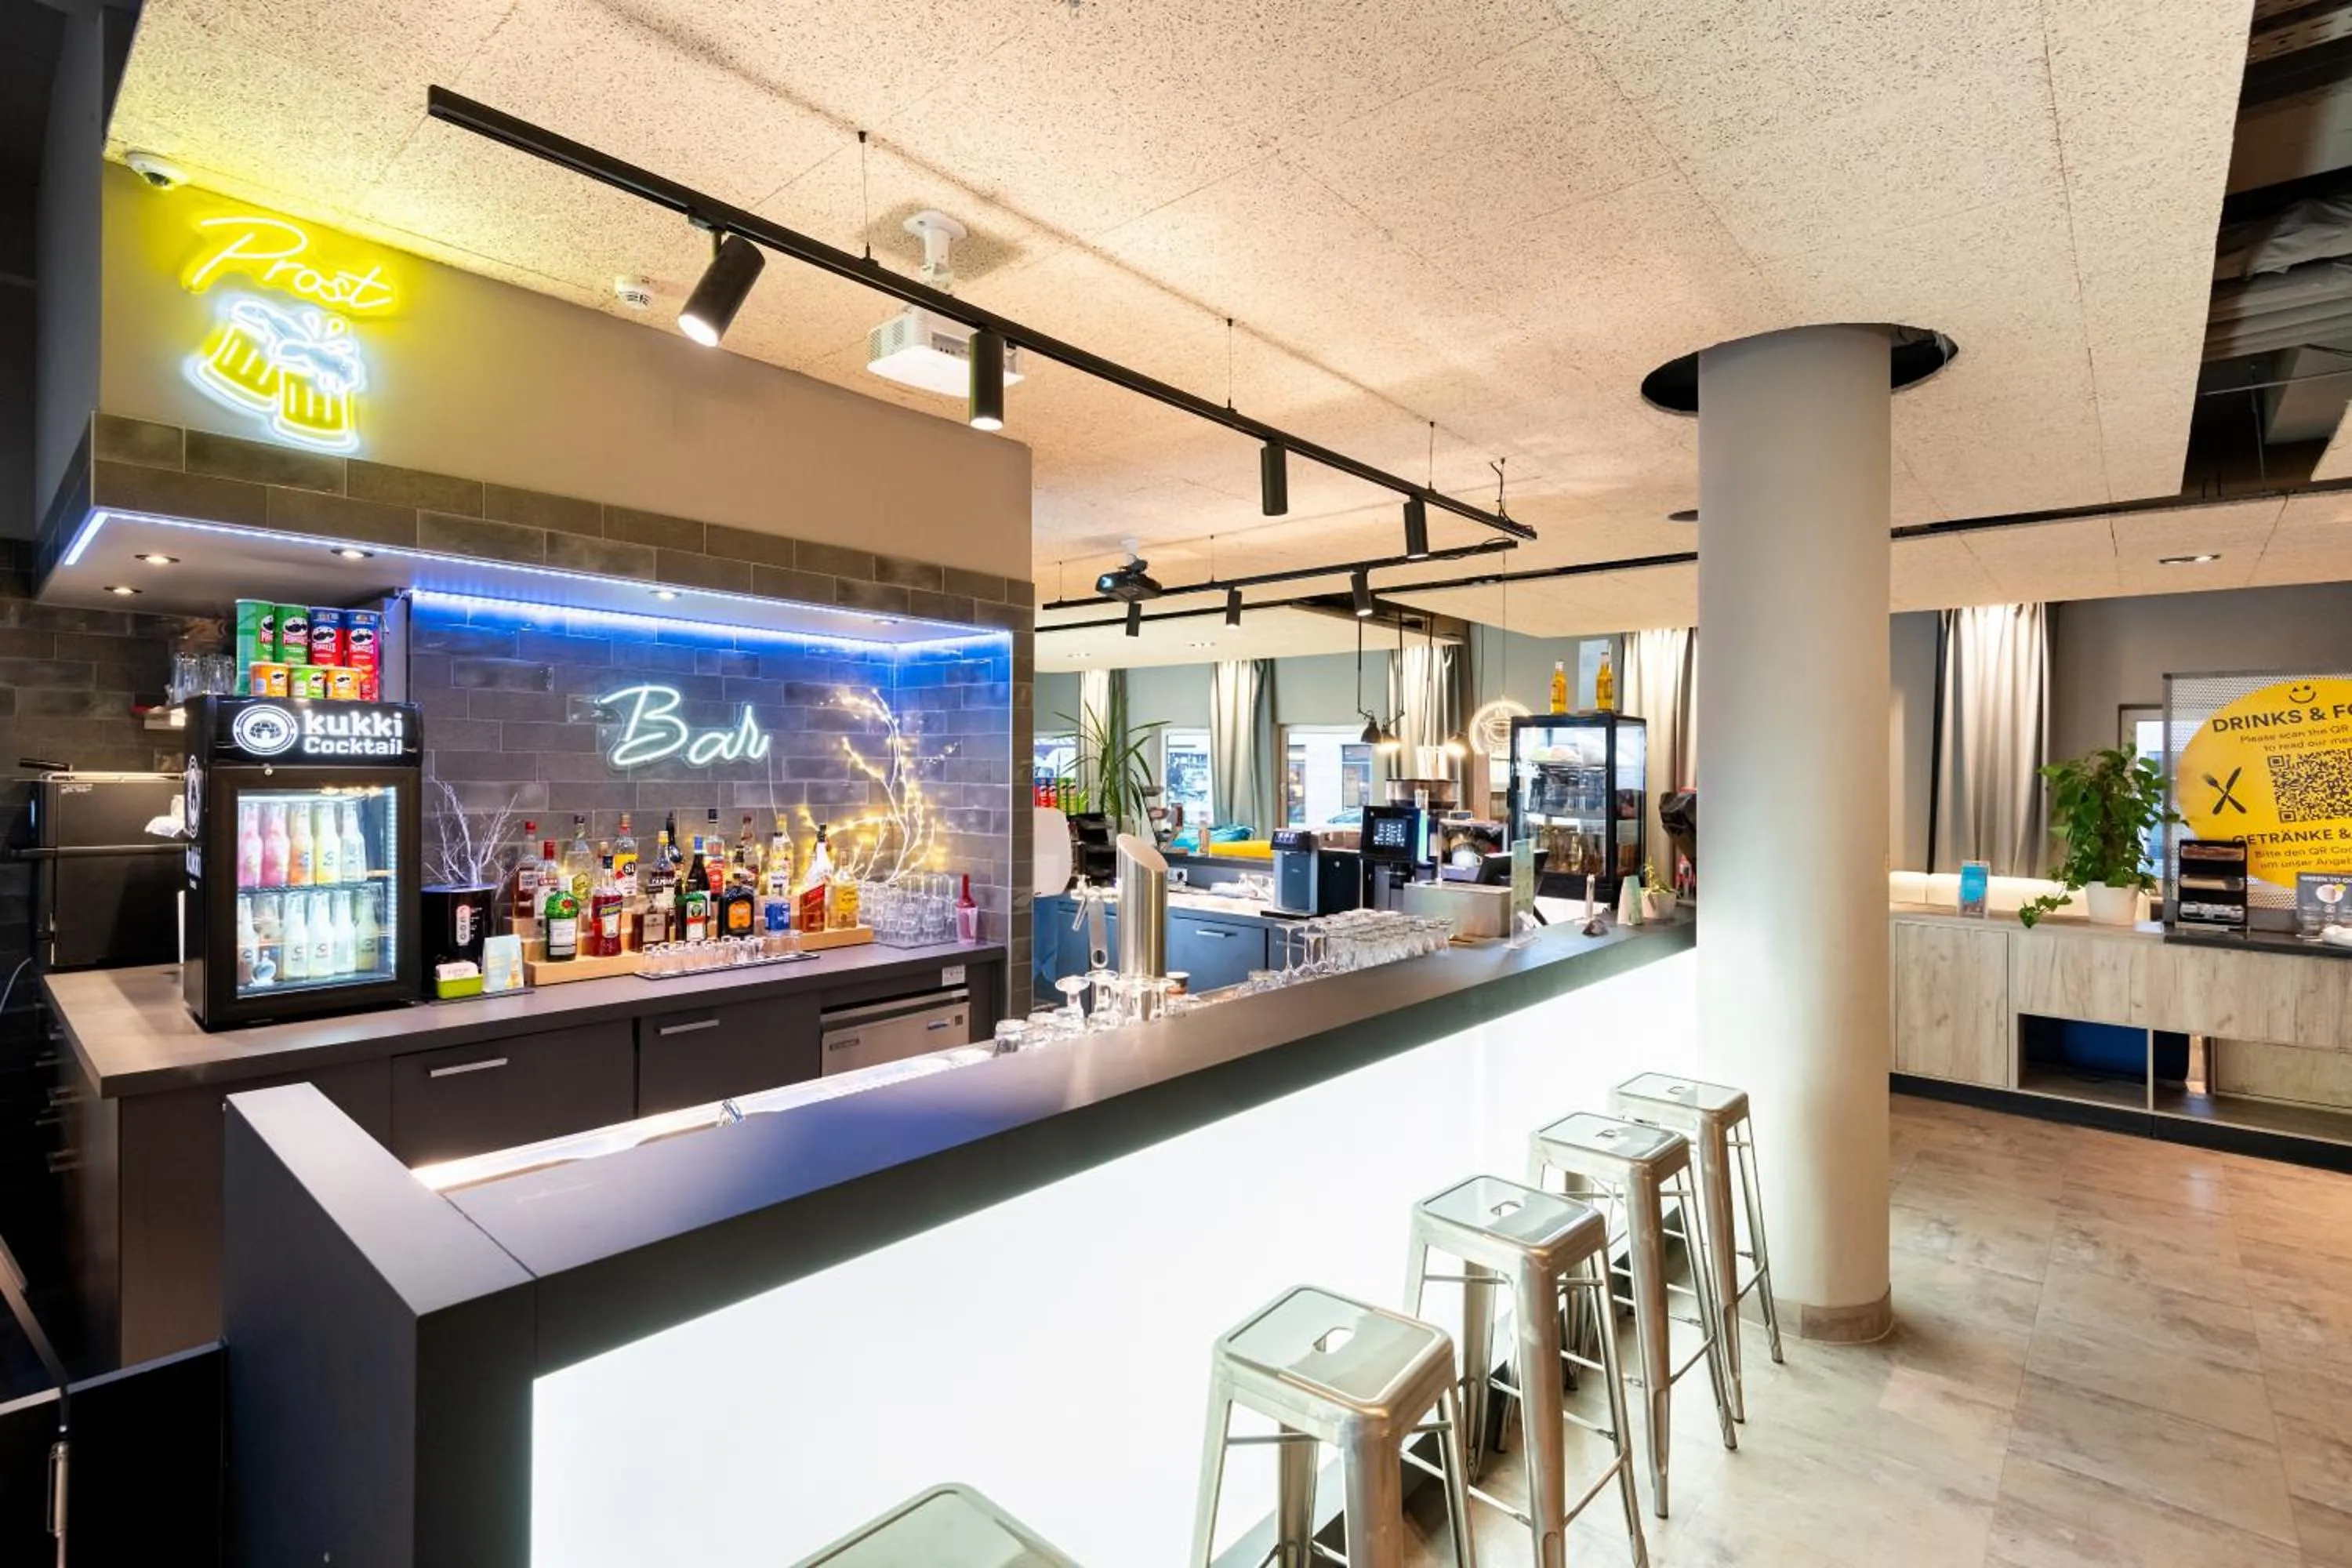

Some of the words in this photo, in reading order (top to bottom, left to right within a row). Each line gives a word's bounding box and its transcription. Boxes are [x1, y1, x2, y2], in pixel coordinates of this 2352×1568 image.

[191, 216, 392, 309] Prost
[302, 709, 404, 738] kukki
[600, 684, 770, 766] Bar
[2212, 710, 2303, 733] DRINKS
[2310, 707, 2328, 721] &
[2240, 735, 2276, 743] Please
[2308, 727, 2328, 736] the
[2329, 724, 2348, 735] QR
[303, 736, 403, 755] Cocktail
[2279, 741, 2304, 750] read
[2339, 827, 2351, 840] &
[2254, 849, 2281, 859] Bitte
[2285, 848, 2306, 857] den
[2309, 846, 2328, 855] QR
